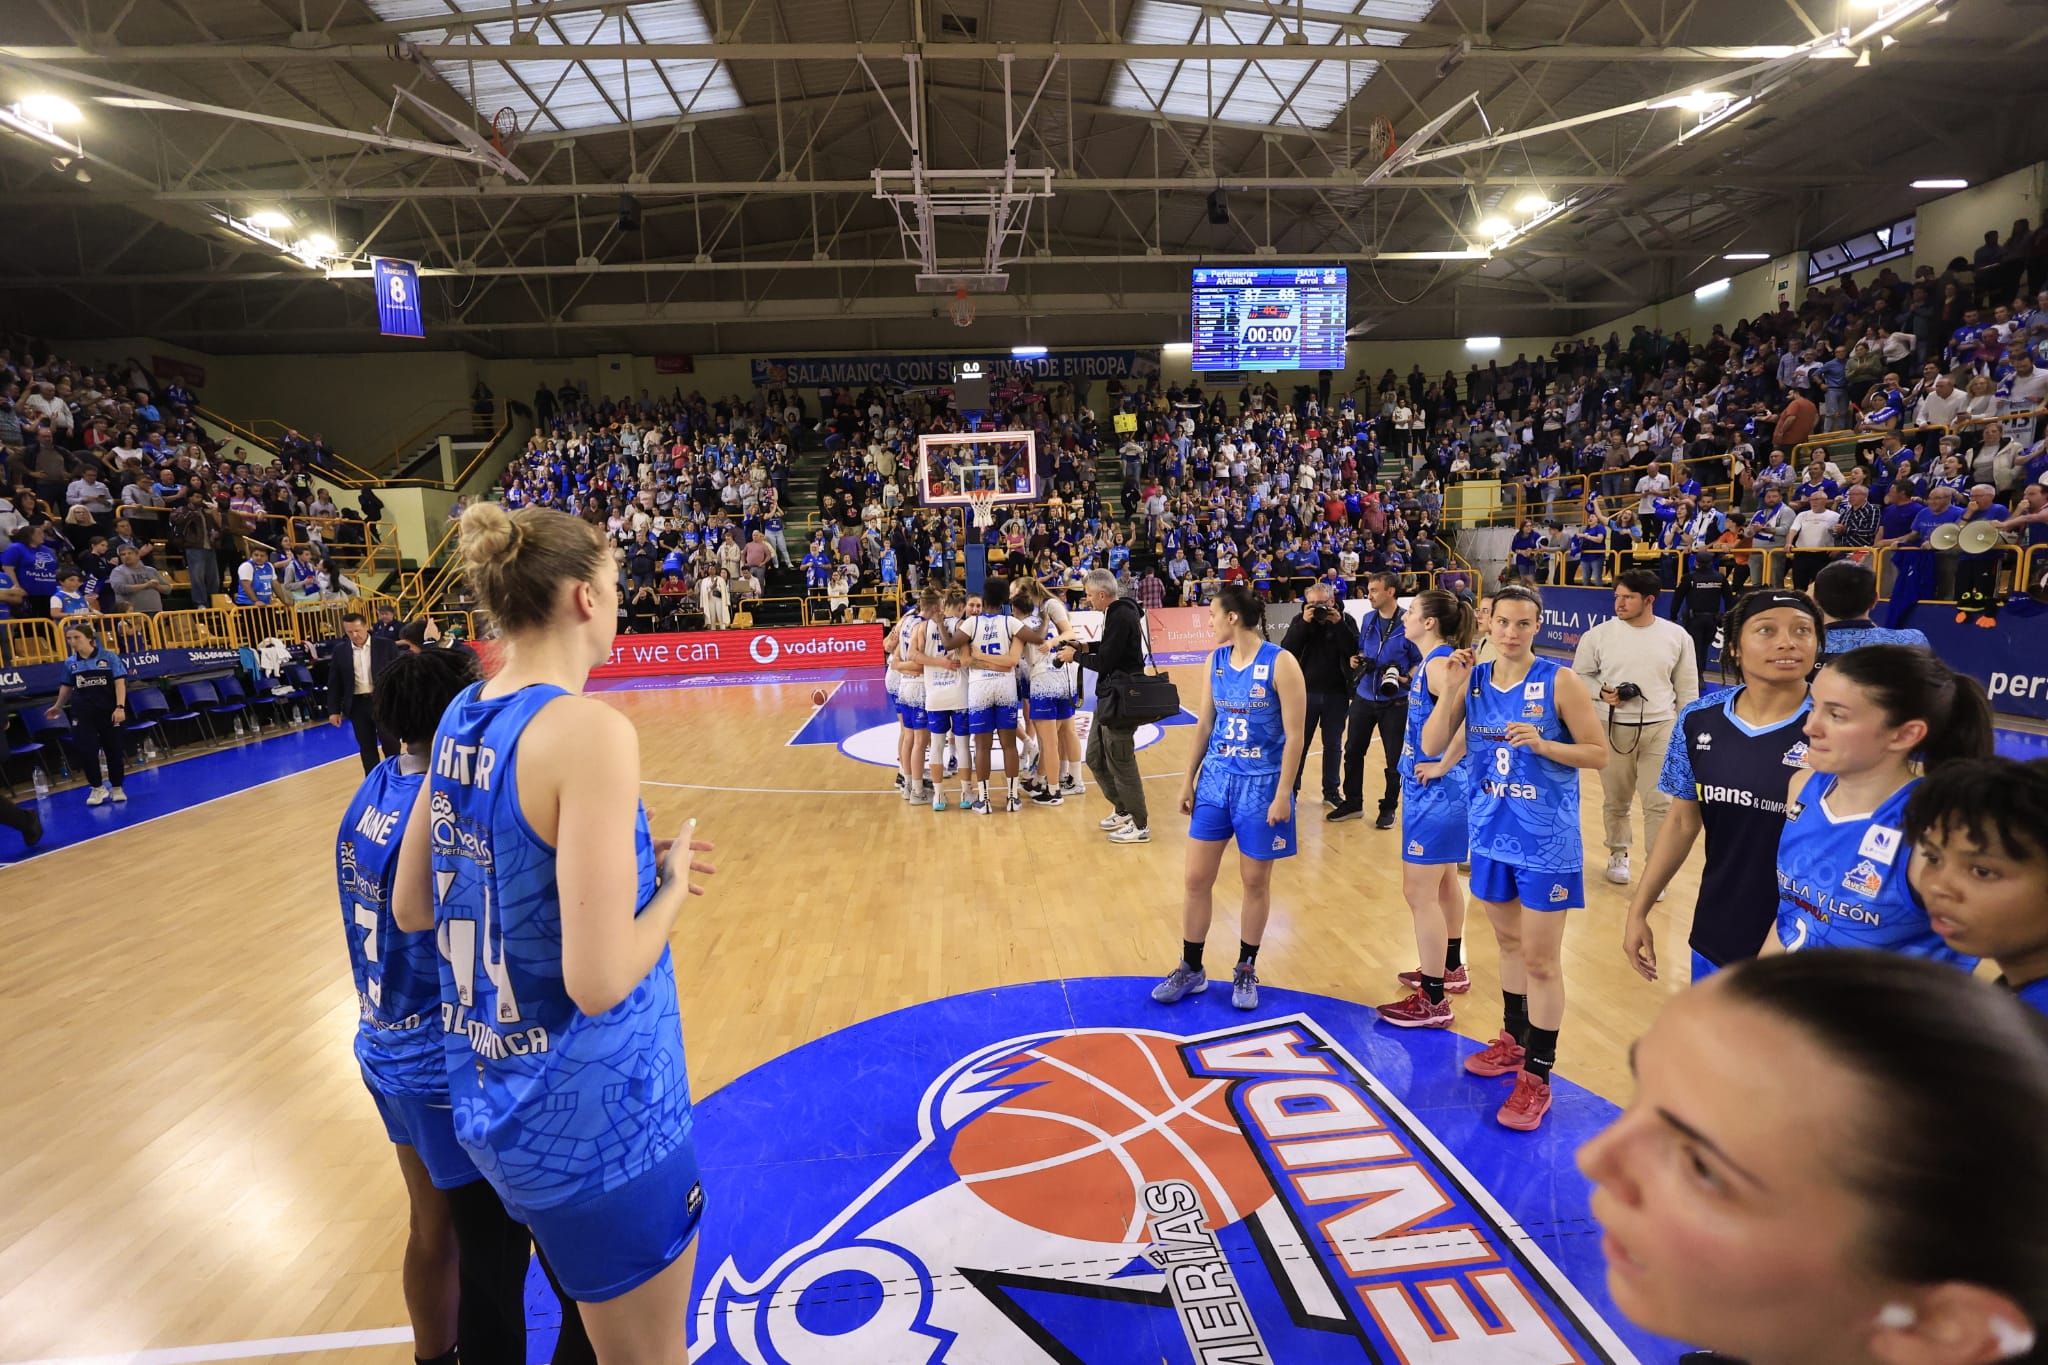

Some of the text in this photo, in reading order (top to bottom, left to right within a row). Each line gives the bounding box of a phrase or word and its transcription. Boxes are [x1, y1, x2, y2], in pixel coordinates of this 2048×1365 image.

[390, 276, 406, 303] 8
[1295, 277, 1319, 285] Ferrol
[1248, 327, 1292, 342] 00:00
[787, 363, 891, 384] SALAMANCA
[897, 361, 933, 381] CON
[1039, 359, 1060, 377] DE
[1064, 356, 1127, 376] EUROPA
[963, 362, 980, 372] 0.0
[1539, 610, 1579, 628] STILLA
[1588, 613, 1597, 629] Y
[1168, 630, 1204, 640] Elizabeth
[1548, 631, 1562, 640] NOS
[633, 645, 668, 663] we
[676, 641, 720, 662] can
[784, 637, 866, 654] vodafone
[134, 652, 159, 666] LEÓN
[1987, 672, 2048, 700] per
[1248, 699, 1269, 707] LEÓN
[1225, 717, 1248, 741] 33
[1470, 726, 1501, 734] ASTILLA
[1496, 748, 1510, 776] 8
[1704, 784, 1788, 814] pans & COMPA
[1817, 892, 1827, 907] Y
[1829, 898, 1880, 927] LEÓN
